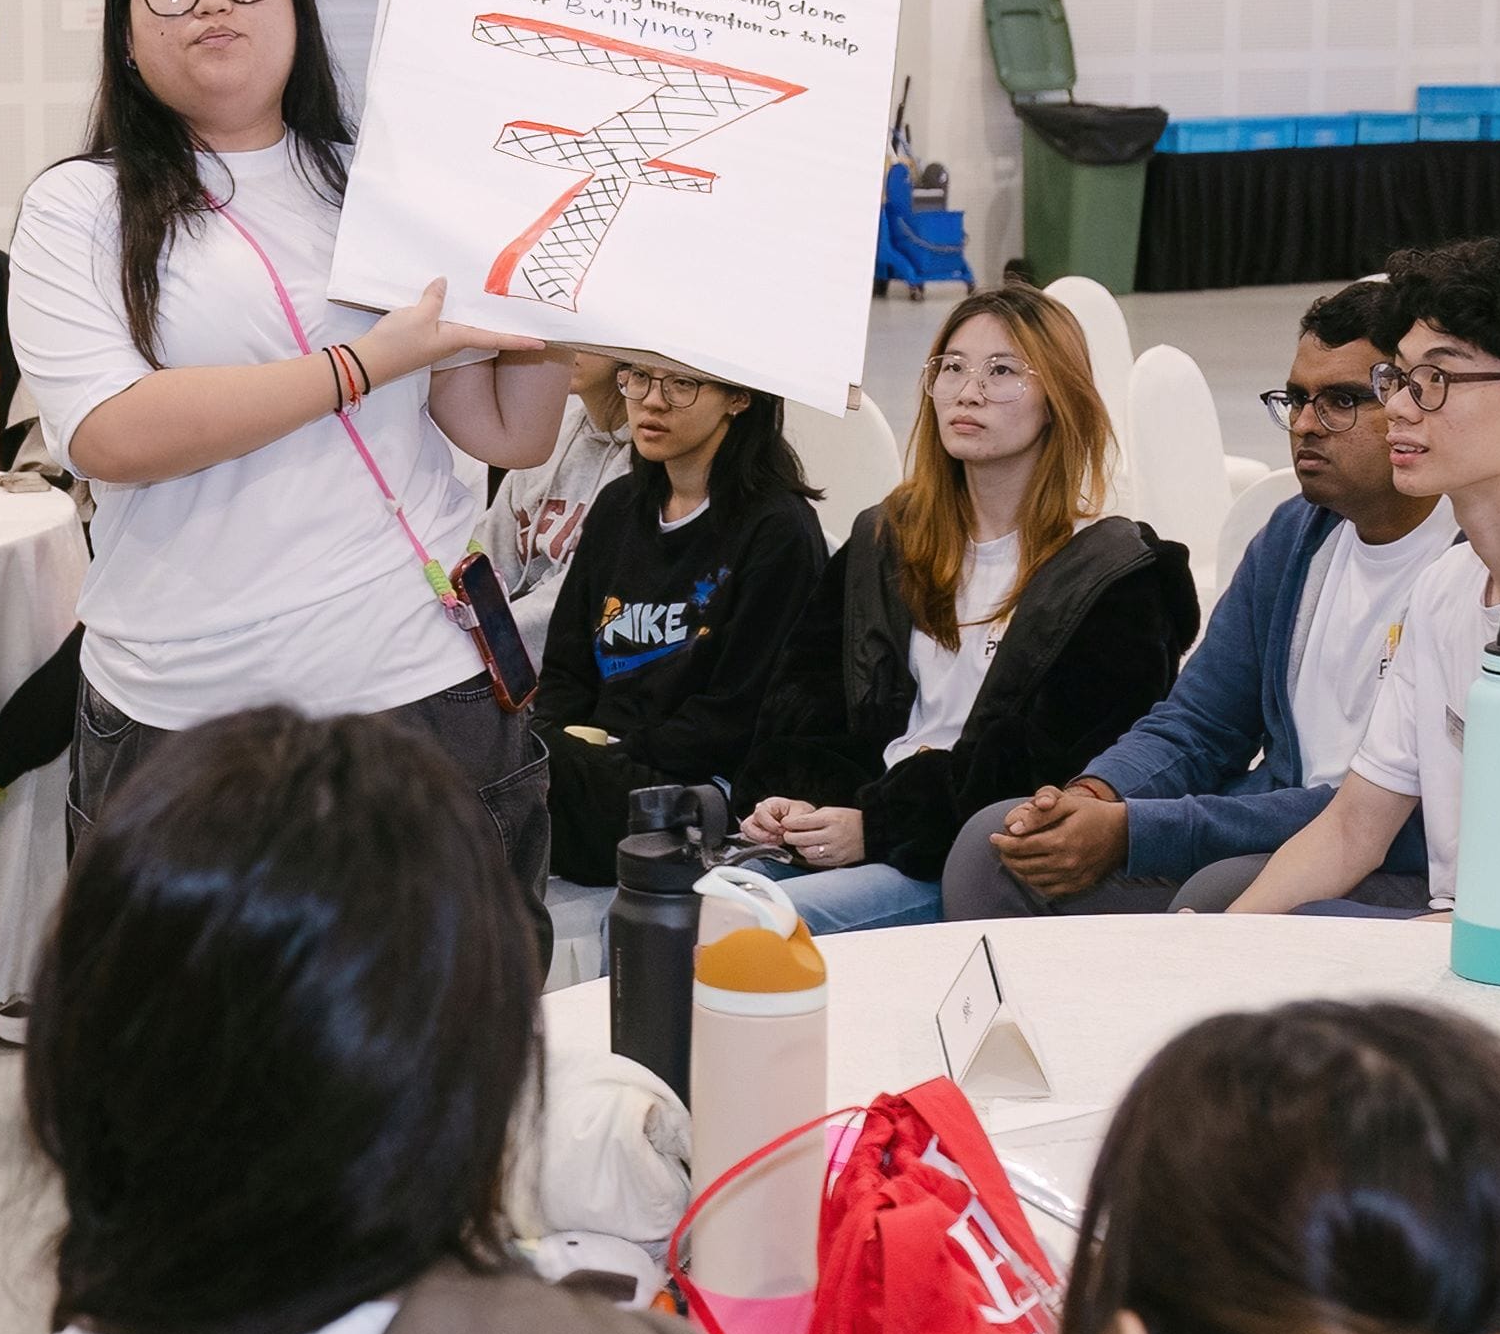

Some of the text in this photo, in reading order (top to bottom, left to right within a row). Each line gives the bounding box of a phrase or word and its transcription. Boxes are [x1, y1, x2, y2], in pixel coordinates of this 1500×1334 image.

[788, 0, 846, 24] done
[769, 28, 791, 38] or
[800, 30, 817, 44] to
[821, 33, 859, 57] help
[603, 602, 689, 647] NIKE
